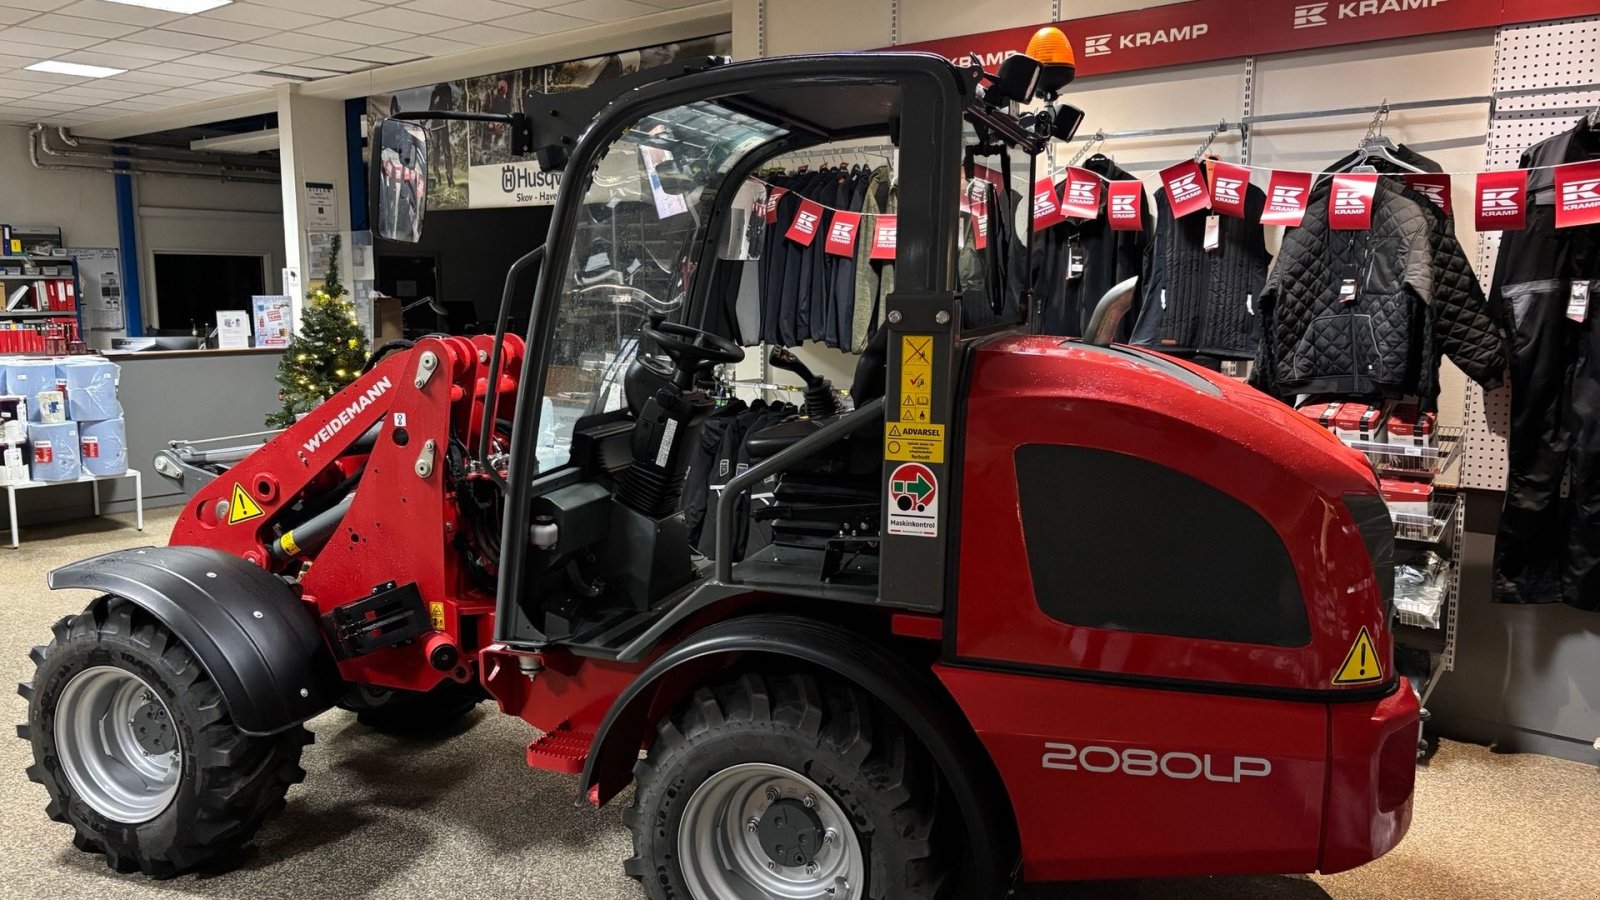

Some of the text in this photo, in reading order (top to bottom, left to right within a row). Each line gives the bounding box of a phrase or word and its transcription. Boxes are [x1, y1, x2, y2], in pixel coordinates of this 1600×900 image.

[1119, 23, 1209, 50] KRAMP
[517, 168, 562, 190] Husqv
[516, 193, 533, 202] Skov
[540, 192, 558, 201] Have
[1174, 190, 1202, 204] KRAMP
[1215, 196, 1240, 205] KRAMP
[1034, 207, 1056, 218] RAMP
[1563, 202, 1600, 212] KRAMP
[302, 376, 393, 454] WEIDEMANN
[902, 427, 940, 437] ADVARSEL
[890, 519, 935, 529] Maskinkontrol
[1042, 742, 1272, 783] 2080LP
